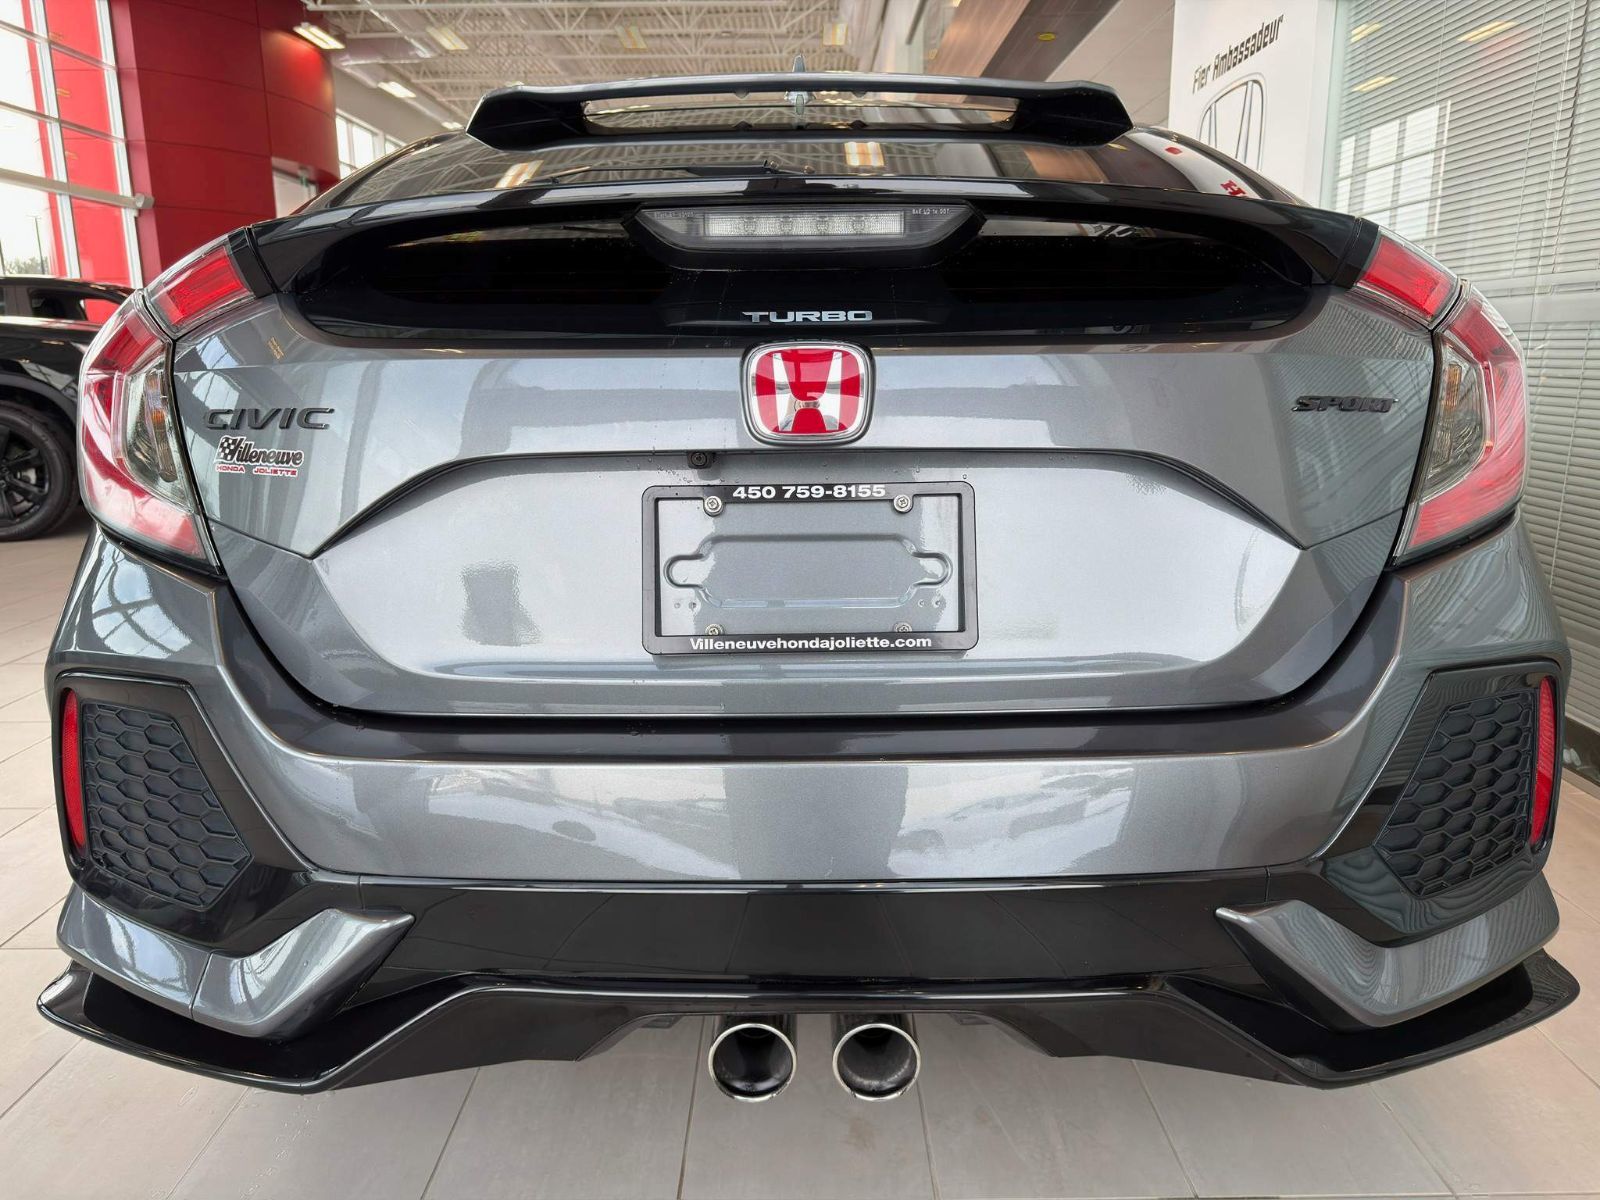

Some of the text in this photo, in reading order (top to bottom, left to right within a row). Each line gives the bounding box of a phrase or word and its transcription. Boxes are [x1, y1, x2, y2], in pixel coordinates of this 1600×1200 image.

[1192, 14, 1284, 94] Fier Ambassadeur
[741, 310, 873, 323] TURBO
[1291, 395, 1399, 413] SPORT
[205, 408, 335, 430] CIVIC
[216, 436, 304, 466] Villeneuve
[216, 465, 298, 476] HONDA JOLIETTE
[732, 485, 886, 499] 450 759-8155
[690, 636, 932, 651] Villeneuvehondajoliette.com
